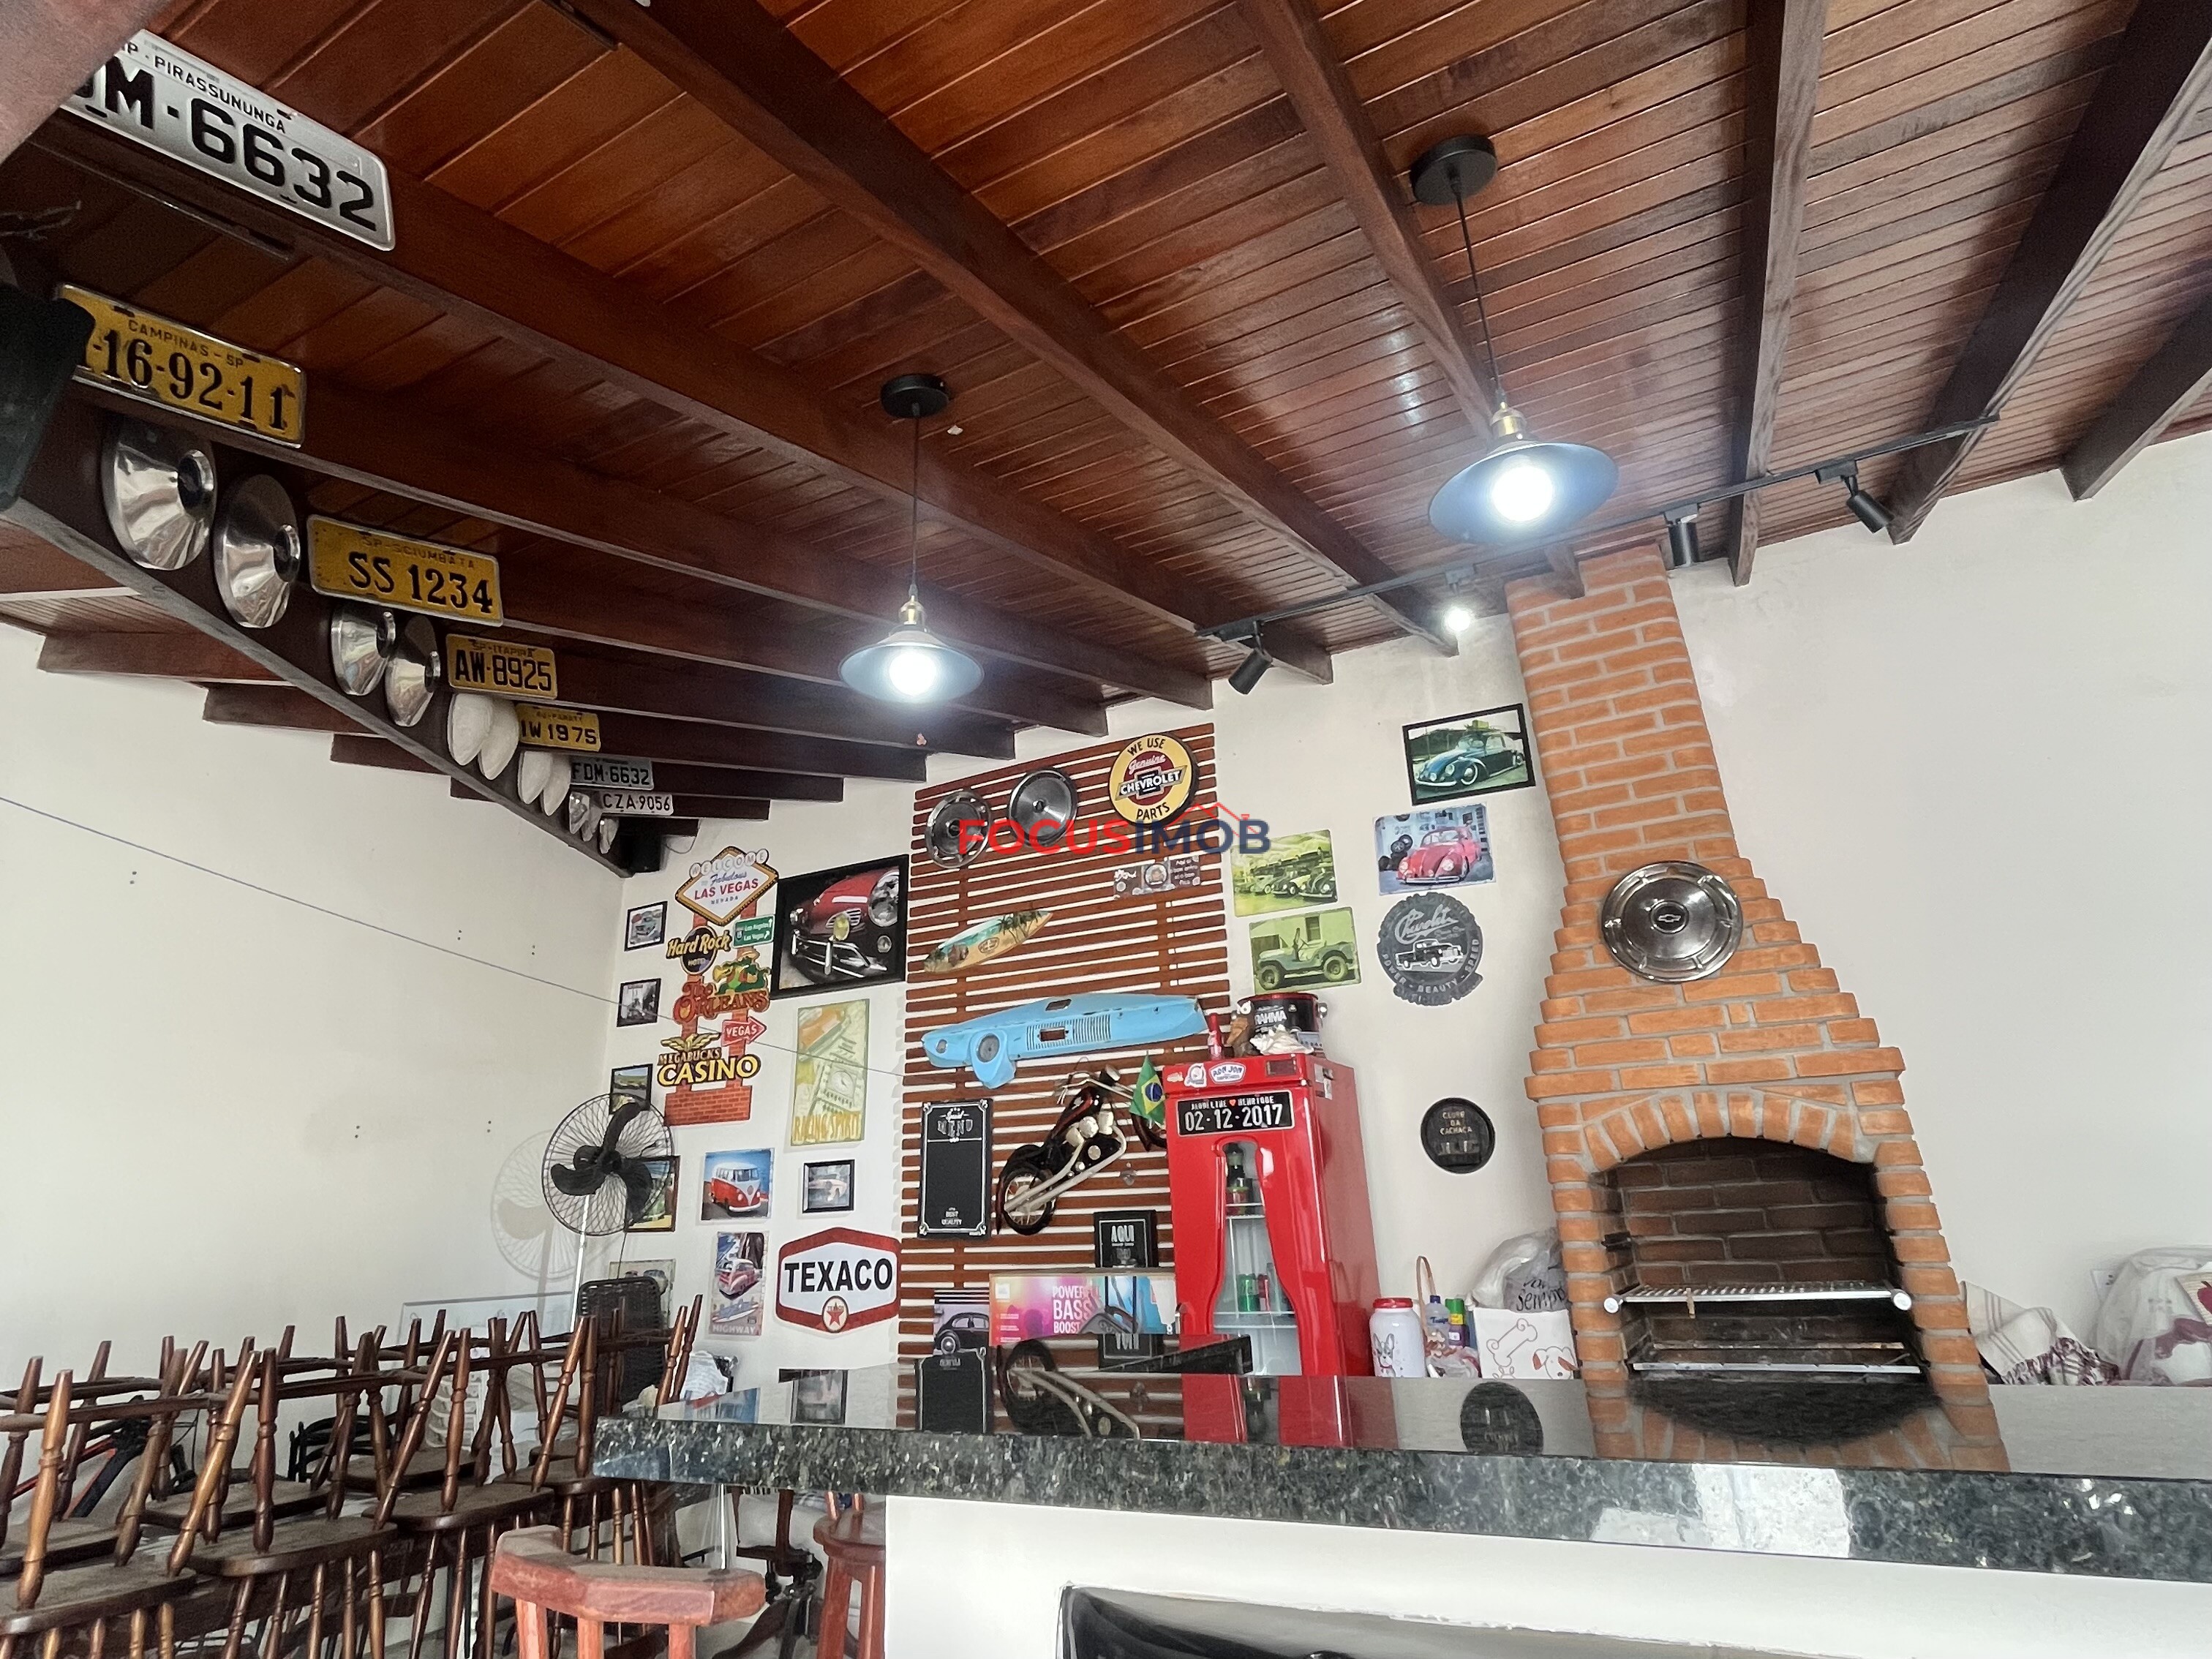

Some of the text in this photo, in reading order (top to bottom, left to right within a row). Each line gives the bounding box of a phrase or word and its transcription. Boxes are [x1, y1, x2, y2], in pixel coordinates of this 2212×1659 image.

[154, 56, 286, 134] PIRASSUNUNGA
[128, 319, 208, 358] CAMPINAS
[225, 354, 244, 369] SP
[347, 551, 493, 614] SS 1234
[548, 723, 597, 745] 1975
[1127, 737, 1166, 756] WE USE
[1128, 754, 1167, 775] Genuine
[1120, 770, 1181, 794] CHEVROLET
[1136, 802, 1170, 821] PARTS
[691, 852, 766, 876] WELCOME
[694, 886, 716, 900] LAS
[720, 878, 759, 895] VEGAS
[710, 871, 748, 886] Fabulous
[1382, 953, 1407, 985] POWER
[1417, 978, 1459, 993] BEAUTY
[1464, 938, 1480, 973] SPEED
[725, 1024, 757, 1038] VEGAS
[658, 1055, 759, 1086] CASINO
[937, 1118, 974, 1137] MENU
[784, 1258, 893, 1293] TEXACO
[1053, 1299, 1093, 1320] BASS
[712, 1324, 756, 1335] HIGHWAY
[1053, 1321, 1081, 1334] BOOST
